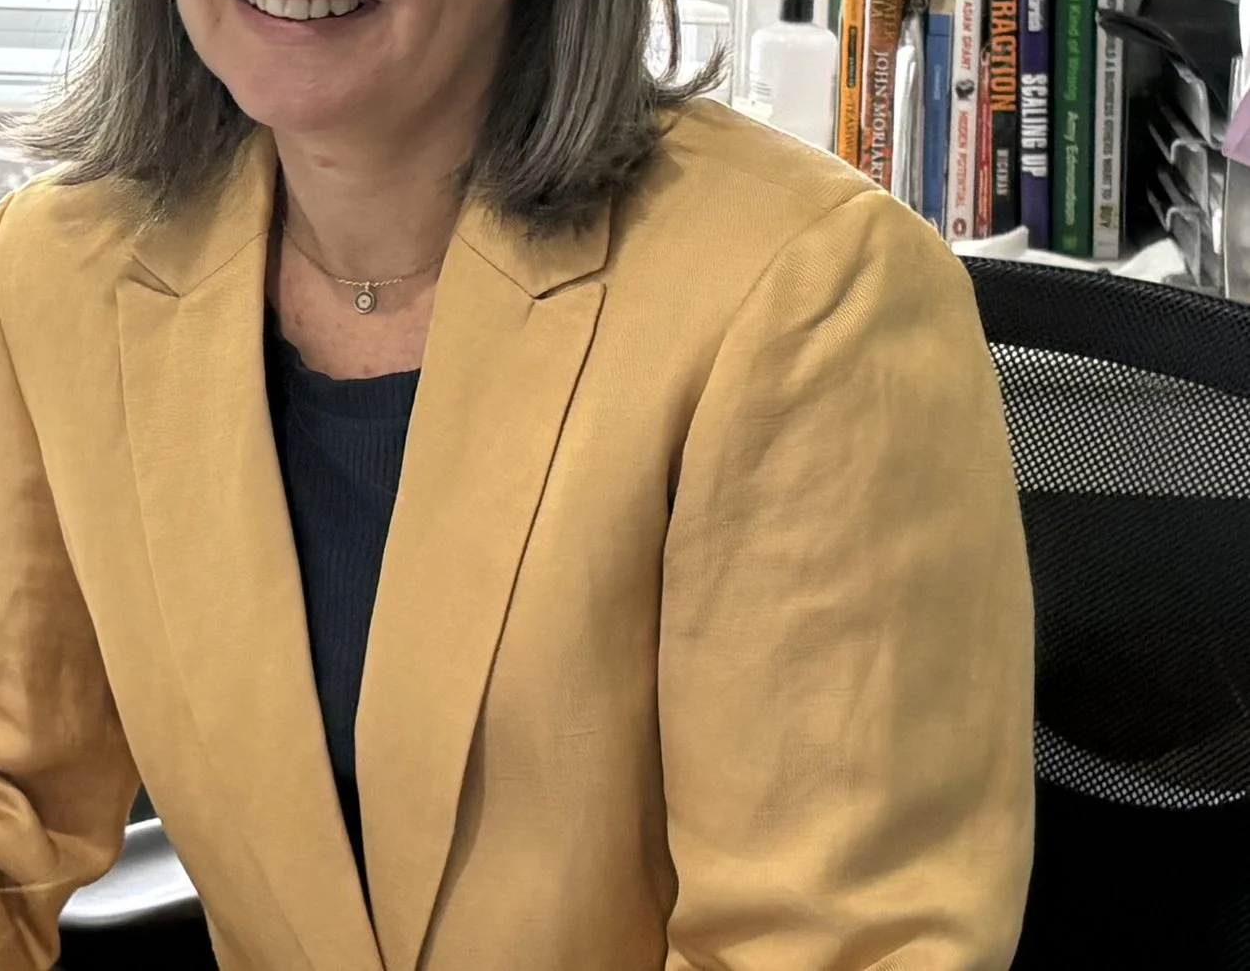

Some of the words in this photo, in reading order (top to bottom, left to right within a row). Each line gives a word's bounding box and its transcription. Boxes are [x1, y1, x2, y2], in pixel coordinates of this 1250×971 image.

[961, 1, 974, 33] ADAM
[960, 36, 973, 70] GRANT
[873, 50, 890, 98] JOHN
[956, 110, 969, 150] HIDDEN
[1021, 73, 1048, 149] SCALING
[1063, 111, 1080, 142] Amy
[869, 102, 890, 182] MORIART
[955, 153, 968, 208] POTENTIAL
[1021, 153, 1048, 177] UP
